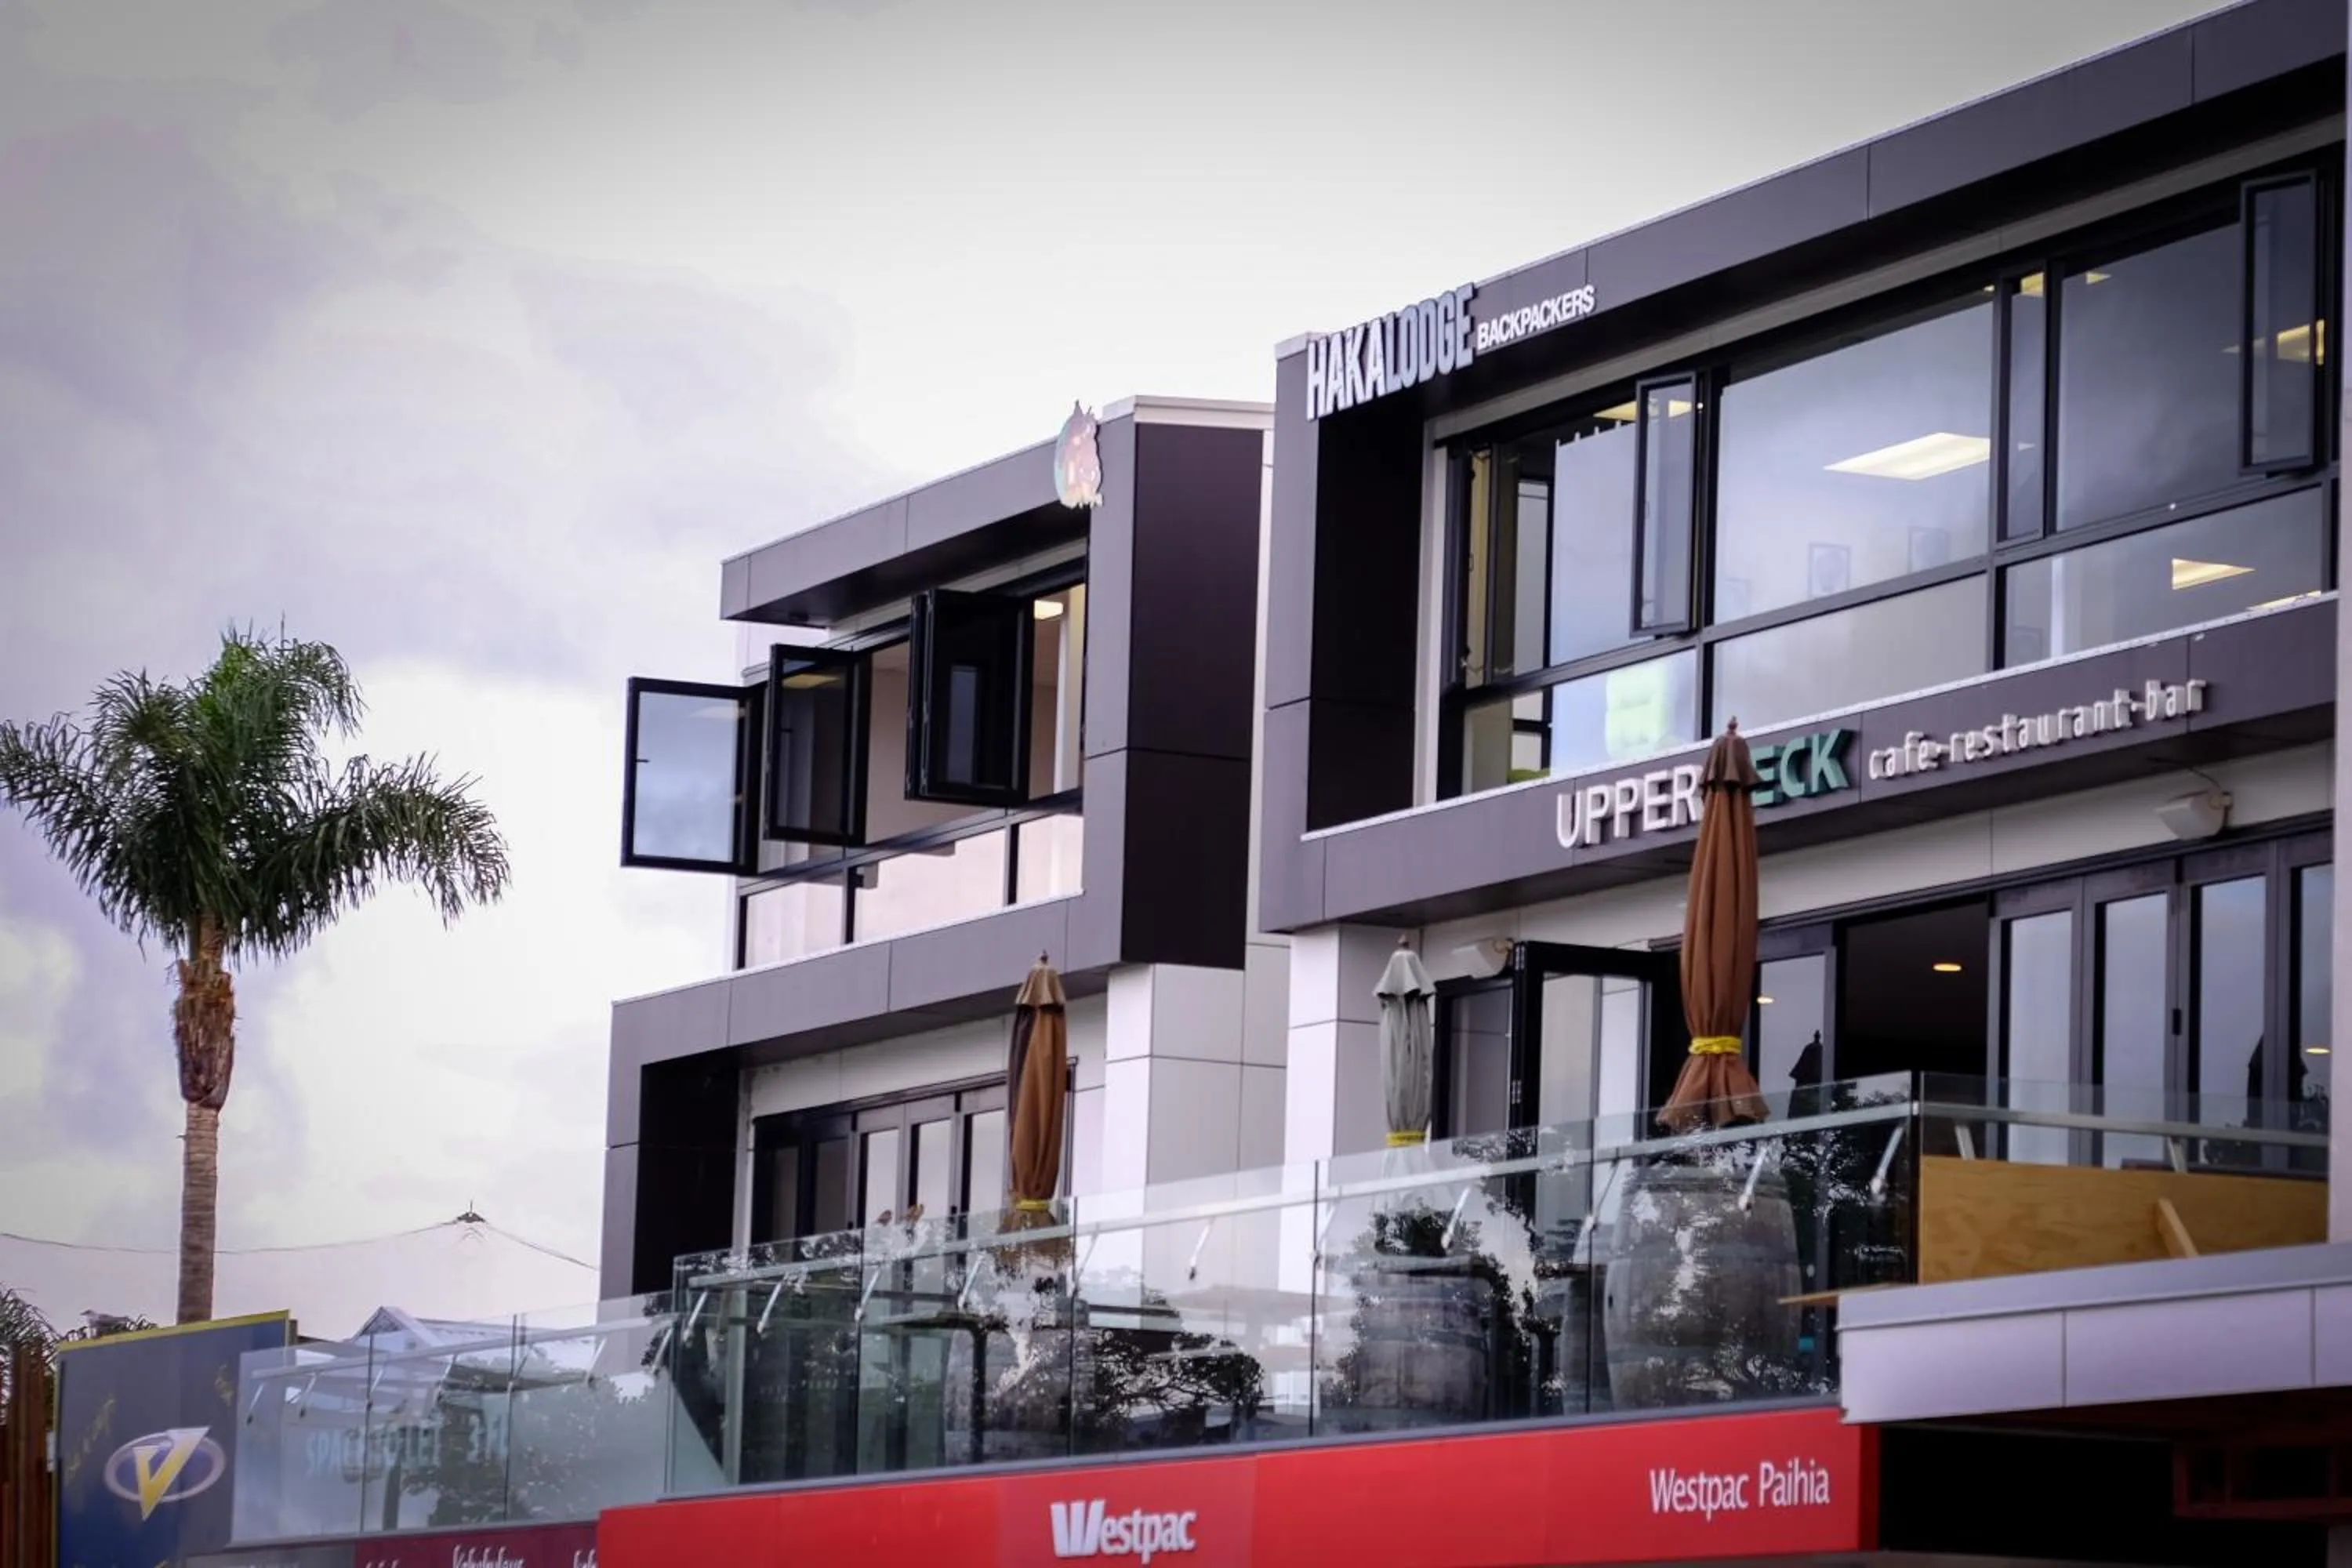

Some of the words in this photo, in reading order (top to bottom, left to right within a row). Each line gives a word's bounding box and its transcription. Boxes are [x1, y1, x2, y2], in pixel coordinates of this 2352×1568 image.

[1476, 285, 1596, 350] BACKPACKERS
[1556, 764, 1703, 849] UPPER
[1750, 728, 1853, 808] ECK
[1650, 1468, 1750, 1523] Westpac
[1759, 1456, 1831, 1508] Paihia
[1051, 1498, 1197, 1565] Westpac
